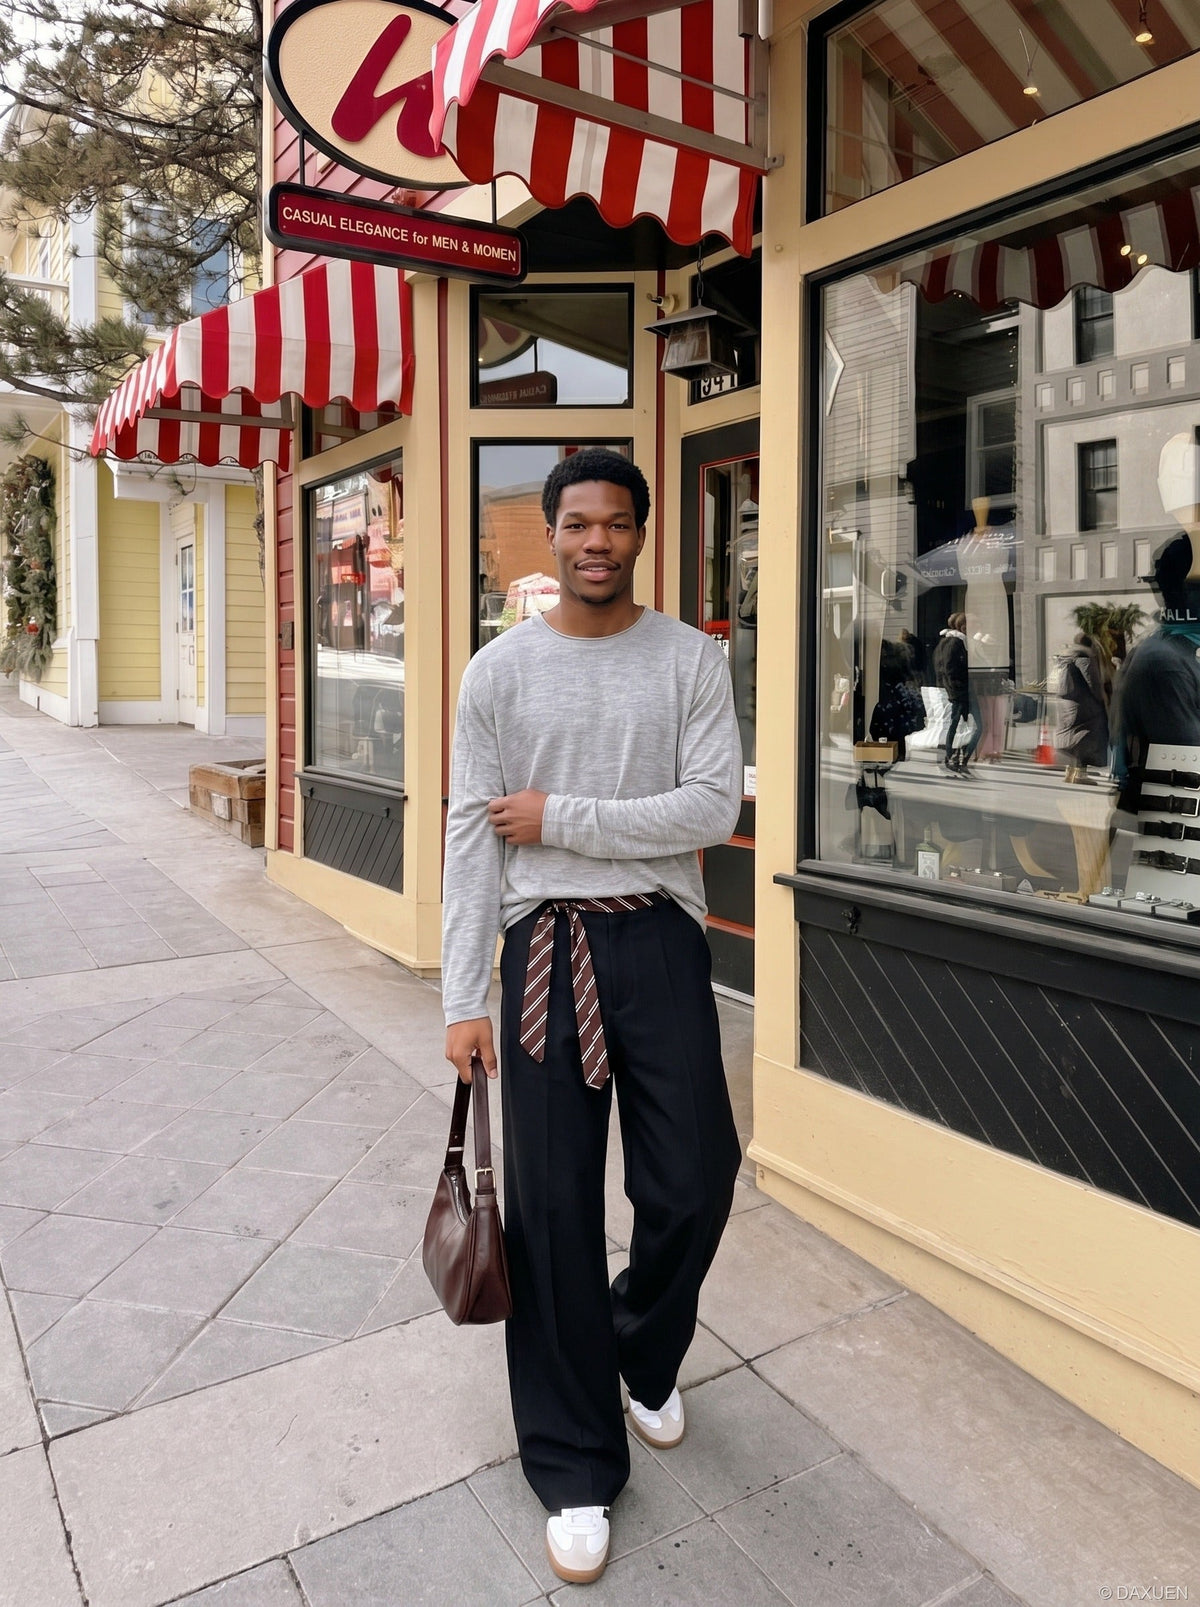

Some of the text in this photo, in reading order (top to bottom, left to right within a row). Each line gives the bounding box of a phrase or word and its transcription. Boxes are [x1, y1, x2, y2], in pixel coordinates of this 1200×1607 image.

[282, 206, 517, 262] CASUAL ELEGANCE for MEN & MOMEN
